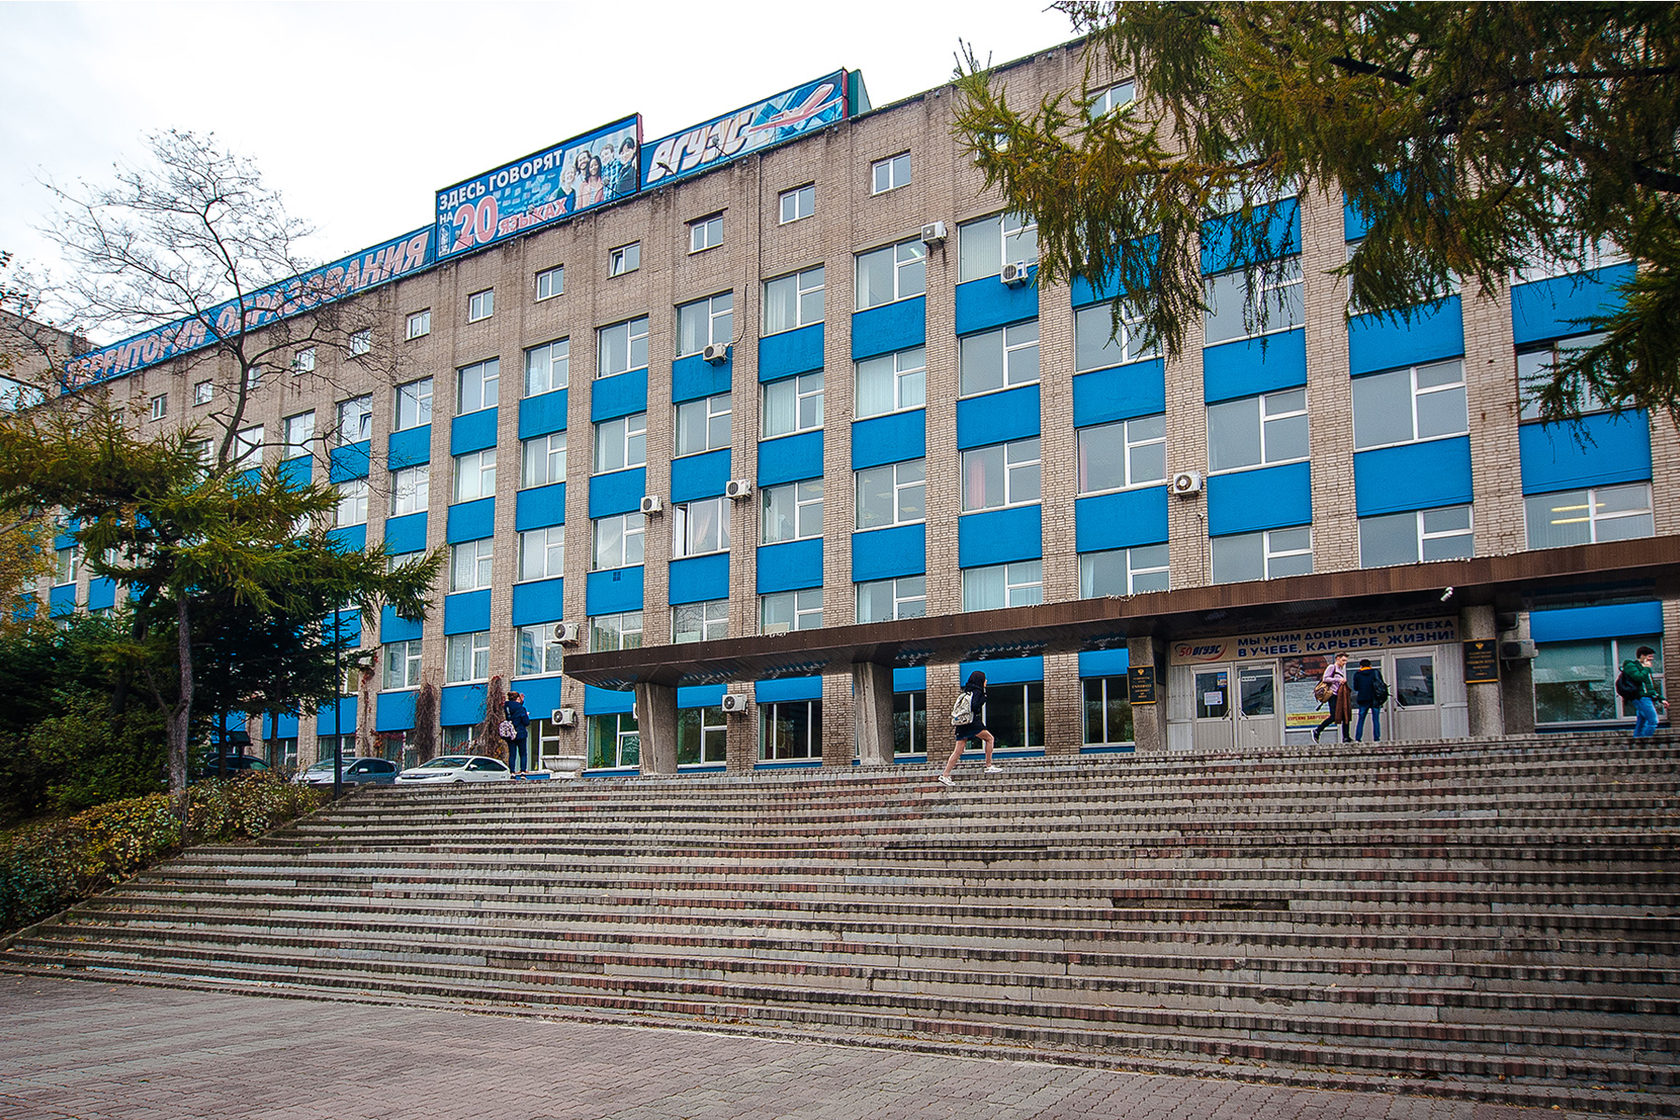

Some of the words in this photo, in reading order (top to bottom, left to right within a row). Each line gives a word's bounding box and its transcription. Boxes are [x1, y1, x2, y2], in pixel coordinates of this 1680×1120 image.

[646, 109, 754, 183] ВГУЭС
[439, 181, 486, 210] ЗДЕСЬ
[489, 149, 563, 191] ГОВОРЯТ
[439, 211, 453, 225] НА
[450, 195, 498, 253] 20
[497, 197, 568, 237] ЯЗЫКАХ
[1179, 647, 1192, 657] 50
[1192, 644, 1221, 656] ВГУЭС
[1237, 637, 1260, 646] МЫ
[1263, 633, 1300, 645] УЧИМ
[1304, 624, 1395, 641] ДОБИВАТЬСЯ
[1397, 619, 1454, 632] УСПЕХА
[1237, 648, 1247, 658] В
[1251, 643, 1302, 657] УЧЕБЕ,
[1306, 636, 1383, 652] КАРЬЕРЕ,
[1387, 630, 1455, 645] ЖИЗНИ!
